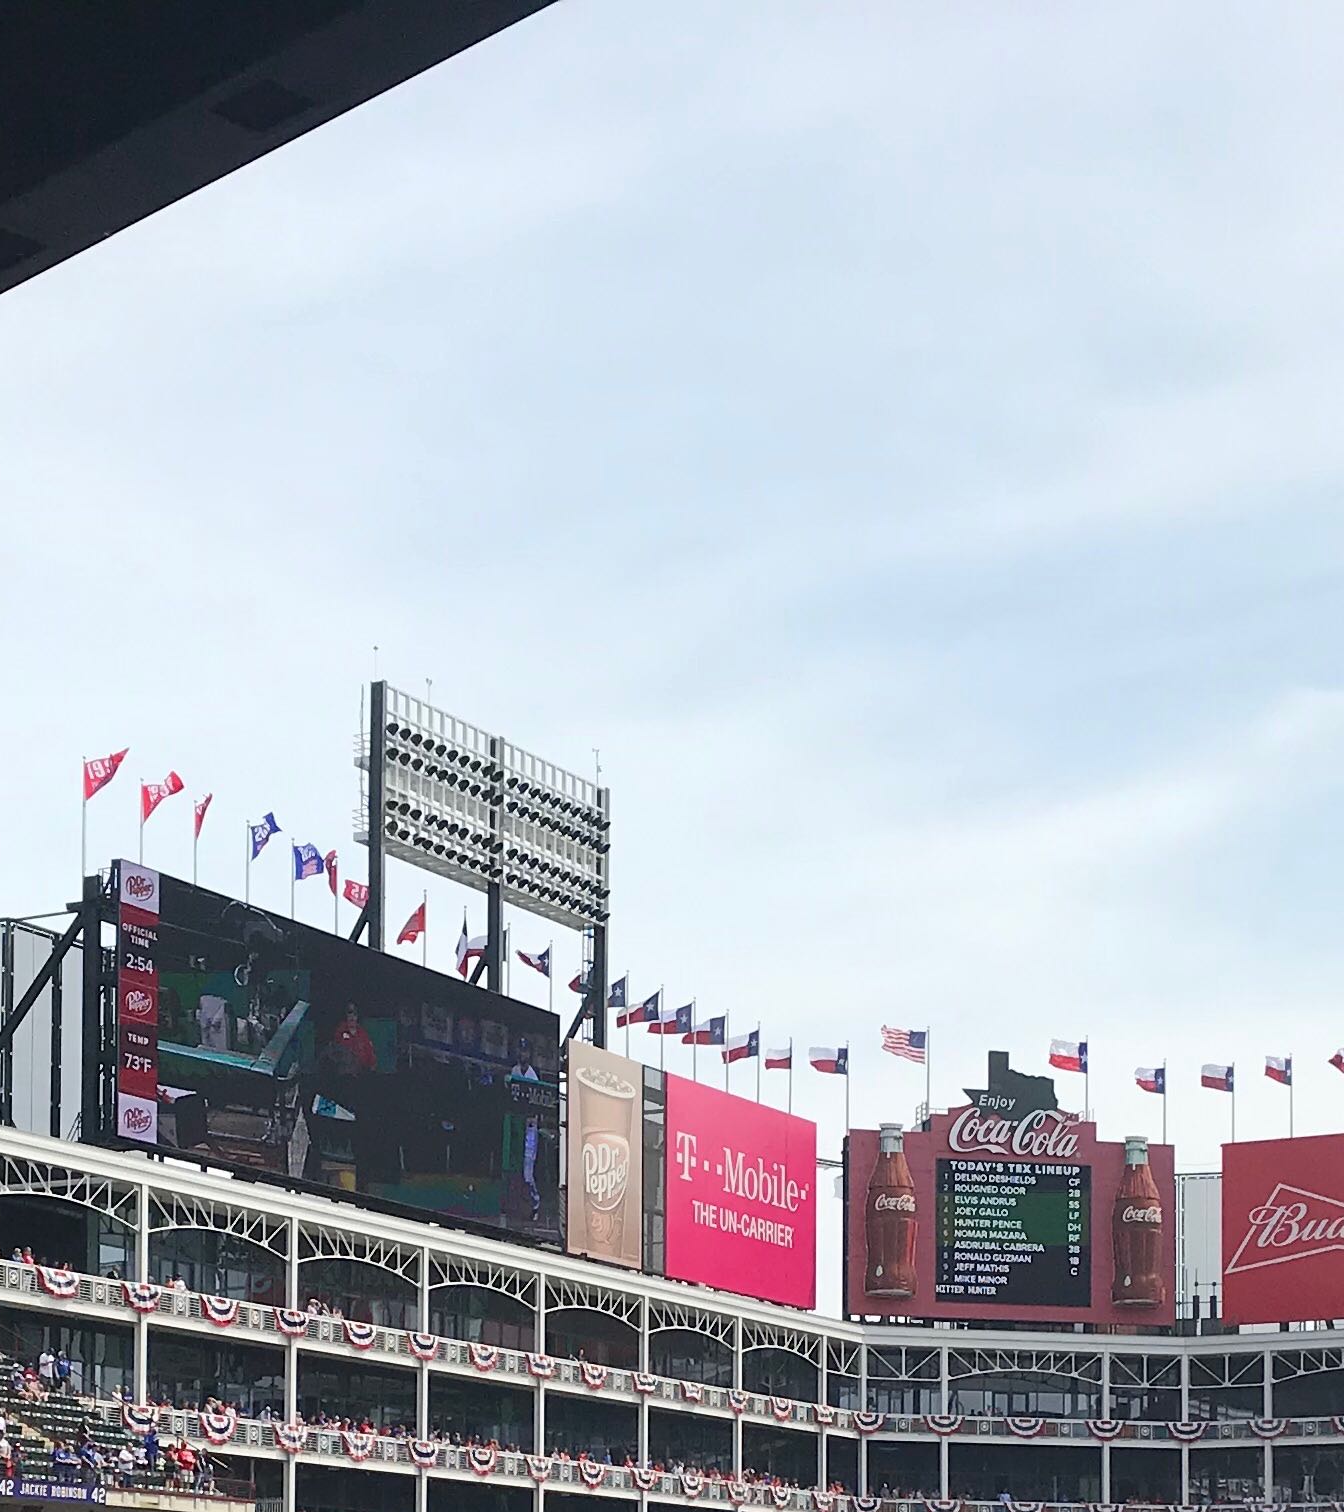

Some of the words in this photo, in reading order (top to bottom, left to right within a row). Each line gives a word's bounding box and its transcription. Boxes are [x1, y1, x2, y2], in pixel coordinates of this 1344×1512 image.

[122, 923, 158, 941] OFFICIAL
[131, 935, 149, 949] TIME
[126, 953, 154, 975] 2:54
[978, 1095, 1016, 1110] Enjoy
[949, 1107, 1078, 1158] Coca-Cola
[597, 1144, 619, 1172] Dr
[582, 1142, 629, 1202] Pepper
[1035, 1164, 1081, 1176] LINEUP
[874, 1193, 916, 1212] Coca-Cola
[692, 1199, 718, 1230] THE
[719, 1206, 795, 1250] UN-CARRIER
[18, 1483, 48, 1498] JACKIE
[50, 1485, 88, 1501] ROBINSON
[90, 1488, 106, 1504] 42
